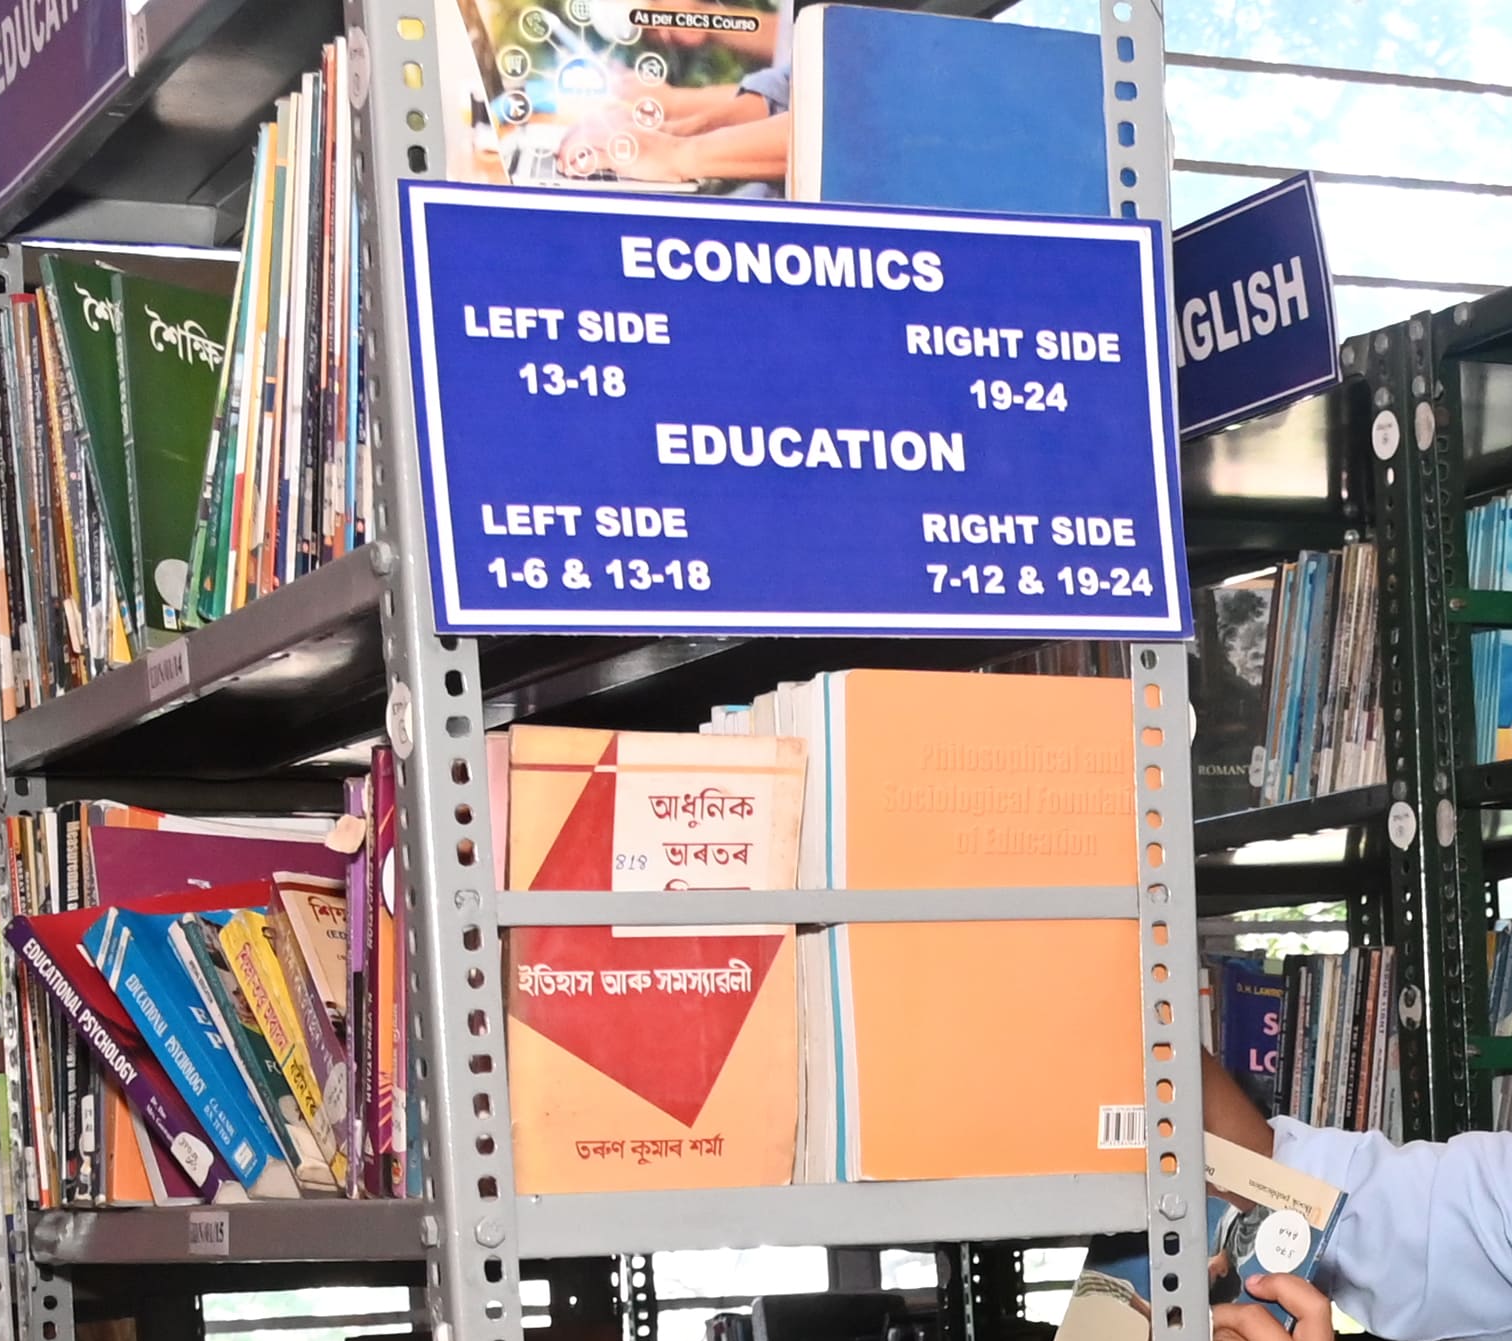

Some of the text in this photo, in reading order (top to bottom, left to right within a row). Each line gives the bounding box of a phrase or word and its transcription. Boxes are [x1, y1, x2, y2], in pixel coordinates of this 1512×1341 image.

[635, 10, 756, 32] As per CBCS Course
[621, 236, 943, 292] ECONOMICS
[464, 306, 1120, 362] LEFT SIDE RIGHT SIDE
[520, 363, 1067, 411] 13-18 19-24
[656, 424, 965, 471] EDUCATION
[482, 504, 1135, 546] LEFT SIDE RIGHT SIDE
[489, 558, 1153, 596] 1-6 & 13-18 7-12 & 19-24
[648, 788, 755, 829] আধুনিক
[519, 964, 593, 997] ইতিহাস
[600, 967, 651, 996] আৰু
[21, 936, 139, 1087] EDUCATIONAL PSYCHOLOGY
[126, 971, 208, 1097] EDUCATIONAL PSYCHOLOGY
